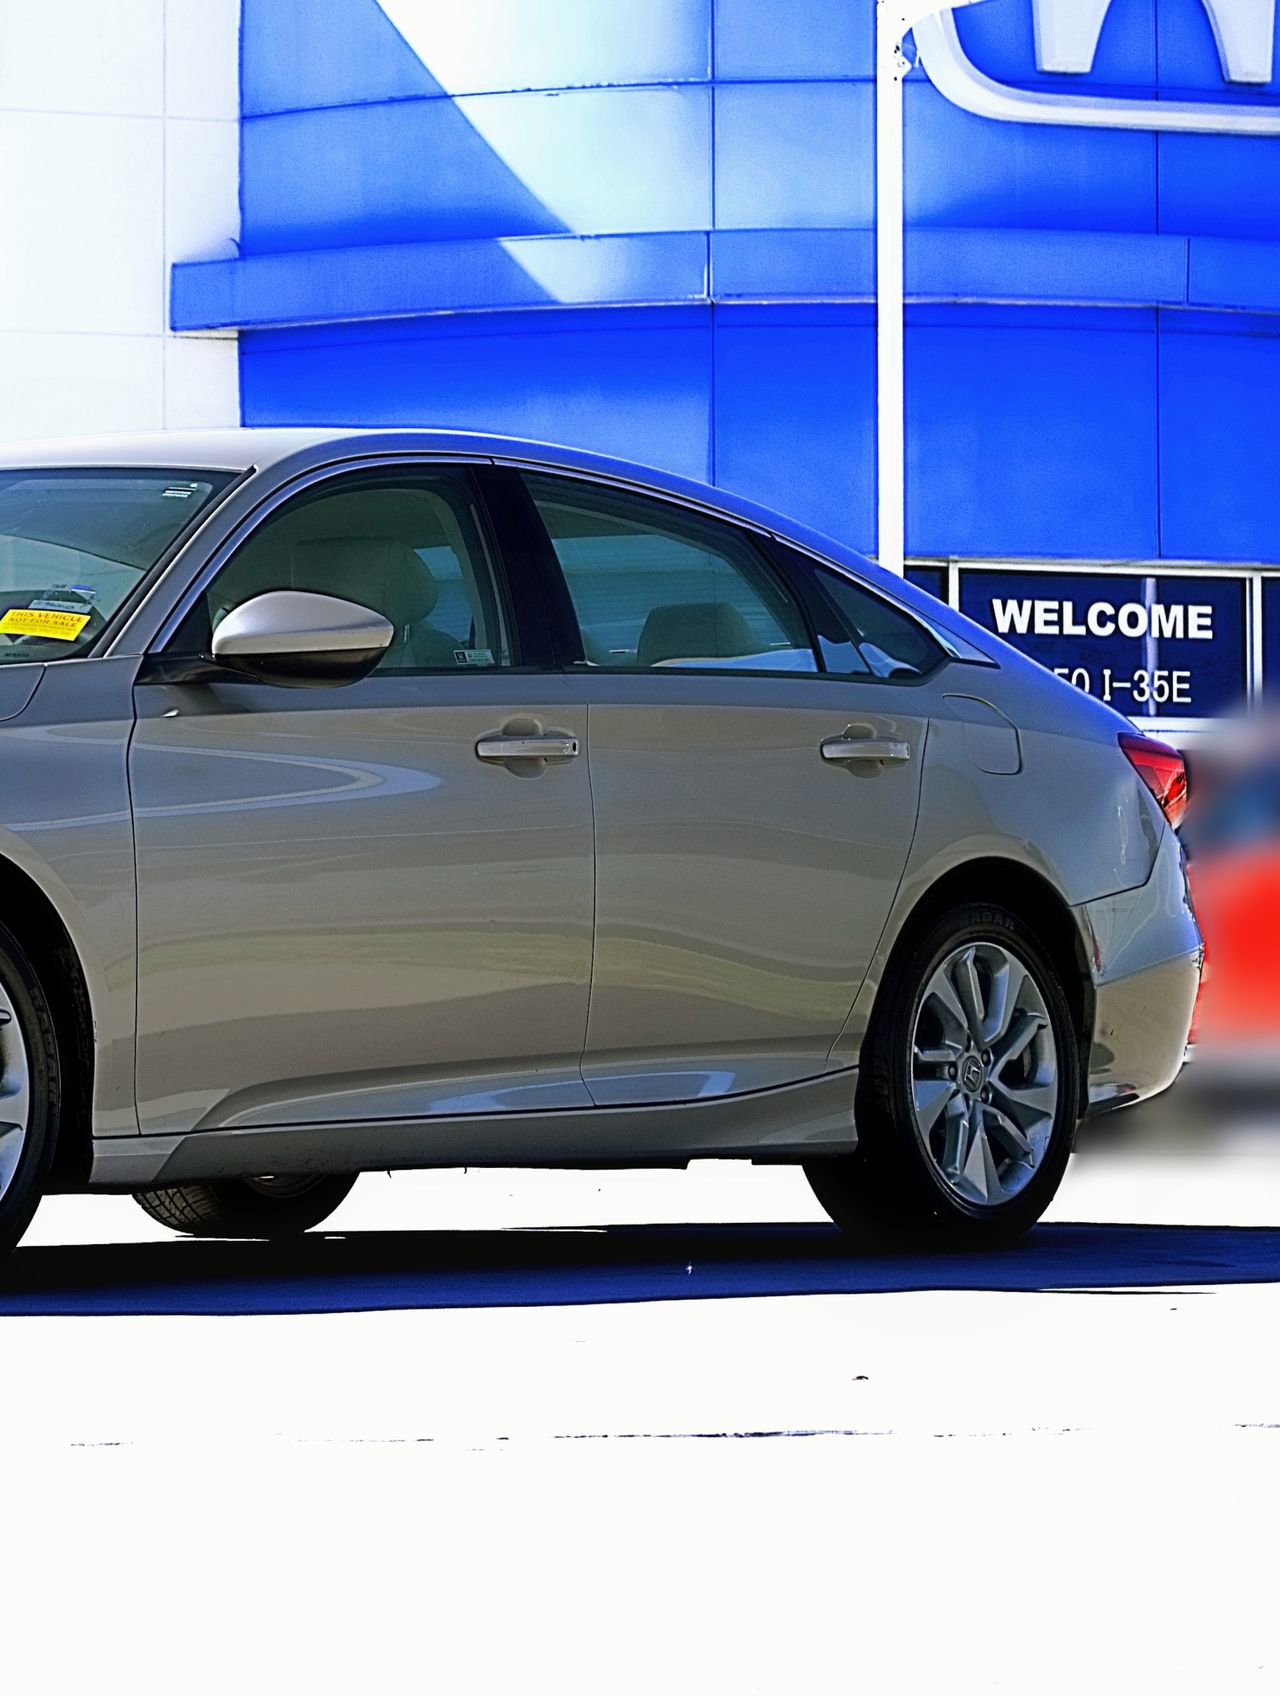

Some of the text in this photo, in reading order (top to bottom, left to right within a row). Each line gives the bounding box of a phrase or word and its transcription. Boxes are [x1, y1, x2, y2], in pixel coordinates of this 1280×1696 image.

[38, 612, 83, 623] VEHICLE
[52, 620, 78, 628] SALE
[991, 598, 1214, 640] WELCOME
[1102, 668, 1192, 703] I-35E
